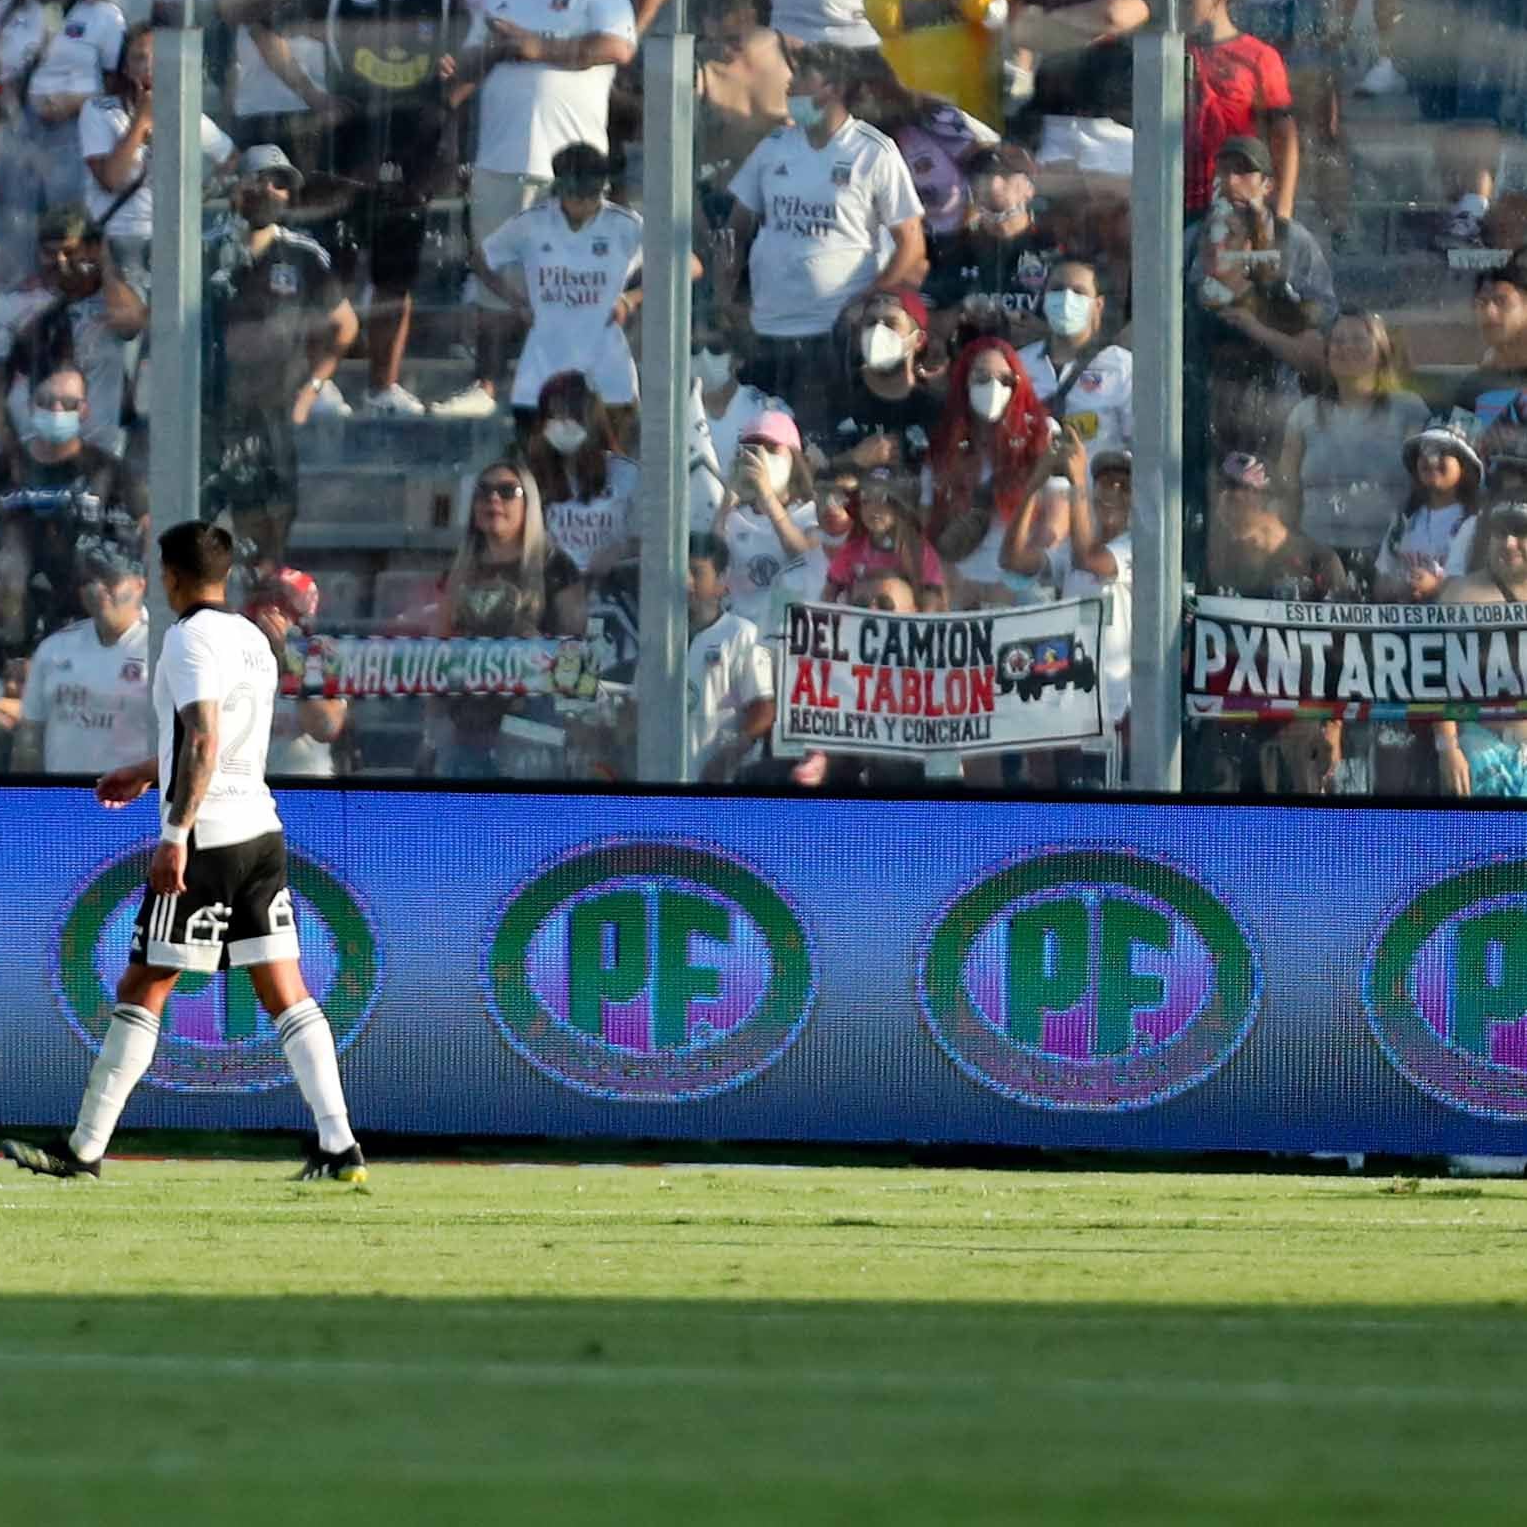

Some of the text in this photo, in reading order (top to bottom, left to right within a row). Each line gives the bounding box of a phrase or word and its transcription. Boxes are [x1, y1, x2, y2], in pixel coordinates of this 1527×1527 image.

[773, 194, 838, 222] Pilsen
[539, 264, 608, 287] Pilsen
[564, 286, 599, 306] Sur
[1286, 603, 1324, 622] ESTE
[1329, 604, 1373, 624] AMOR
[1378, 605, 1398, 624] NO
[1404, 605, 1424, 624] ES
[1428, 604, 1468, 624] PARA
[789, 604, 995, 668] DEL CAMION
[790, 656, 996, 717] AL TABLON
[790, 708, 992, 745] RECOLETA Y CONCHALI
[568, 889, 730, 1050] PF
[1008, 895, 1173, 1059] PF
